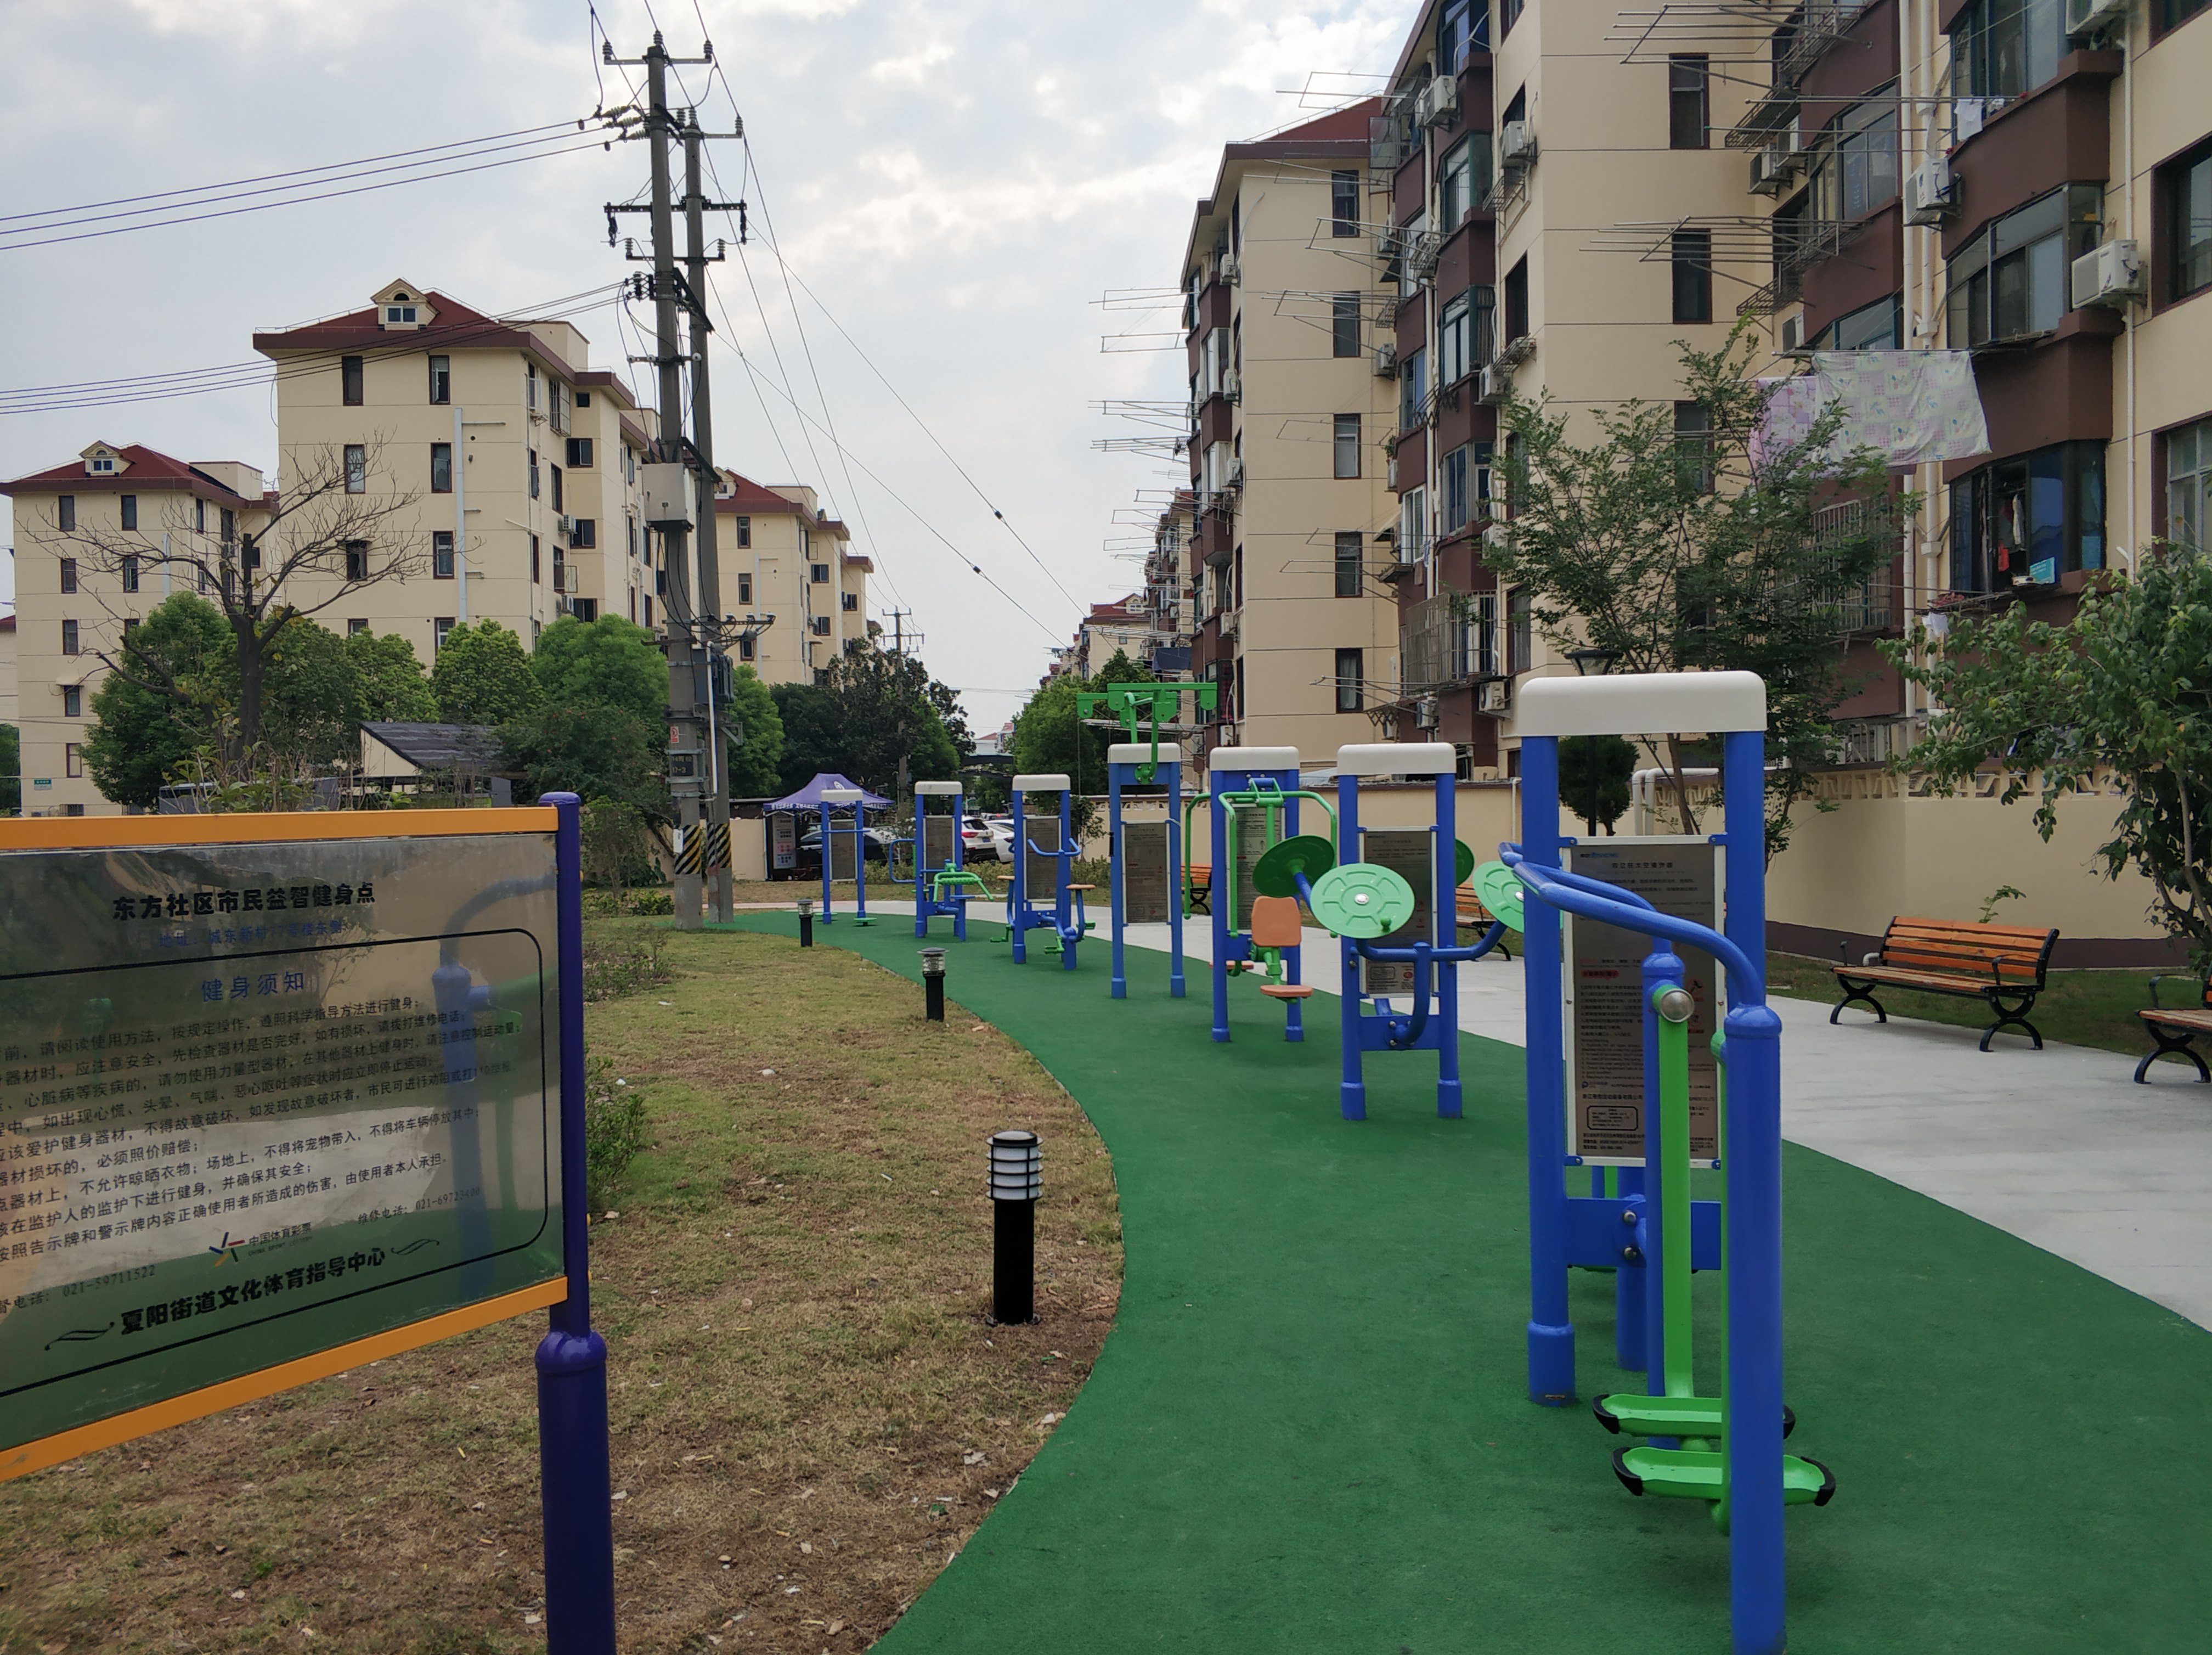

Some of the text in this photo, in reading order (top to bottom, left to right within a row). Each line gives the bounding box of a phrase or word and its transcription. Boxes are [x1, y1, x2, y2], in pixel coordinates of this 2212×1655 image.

[112, 882, 376, 921] 东方社区市民益智健身点
[202, 971, 304, 1003] 健身须知
[0, 996, 419, 1062] 前，请阅读使用方法，按规定操作，遵照科学指导方法进行健身；
[0, 1010, 466, 1087] 器材时，应注意安全，先检查器材是否完好，如有损坏，请拨打维修电话；
[249, 1221, 312, 1246] 中国体育彩票
[121, 1247, 385, 1336] 夏阳街道文化体育指导中心
